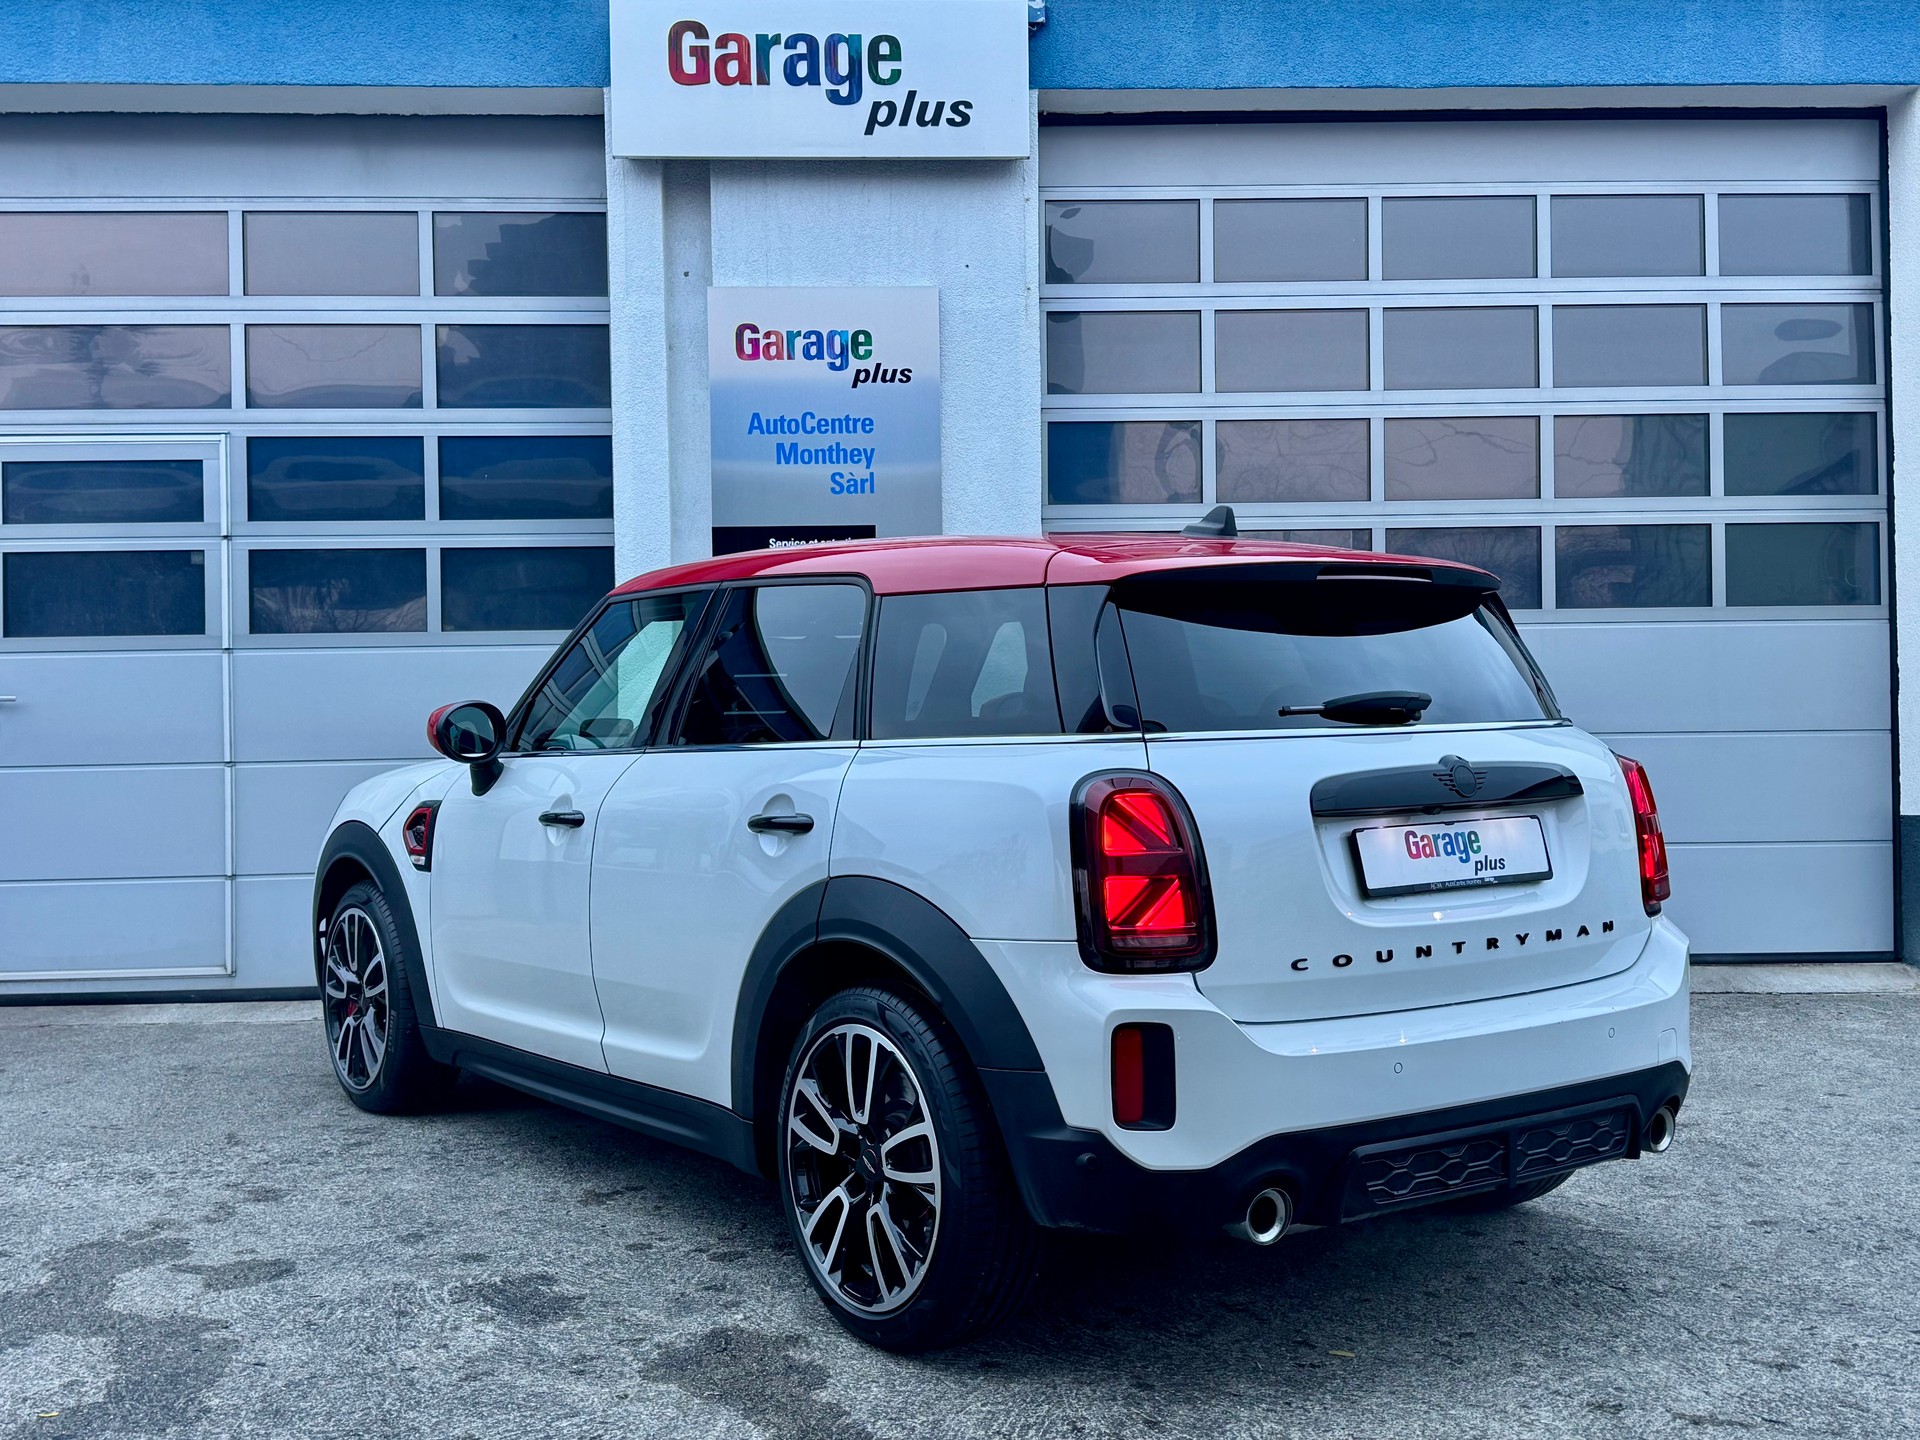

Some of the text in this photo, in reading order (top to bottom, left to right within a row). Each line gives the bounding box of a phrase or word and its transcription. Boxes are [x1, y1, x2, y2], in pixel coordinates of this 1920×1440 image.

[667, 20, 902, 105] Garage
[864, 89, 973, 136] plus
[735, 323, 873, 372] Garage
[851, 362, 913, 389] plus
[747, 411, 875, 436] AutoCentre
[775, 441, 876, 470] Monthey
[829, 471, 876, 495] Sàrl
[1404, 829, 1482, 864] Garage
[1474, 854, 1506, 876] plus
[1290, 919, 1616, 972] COUNTRYMAN
